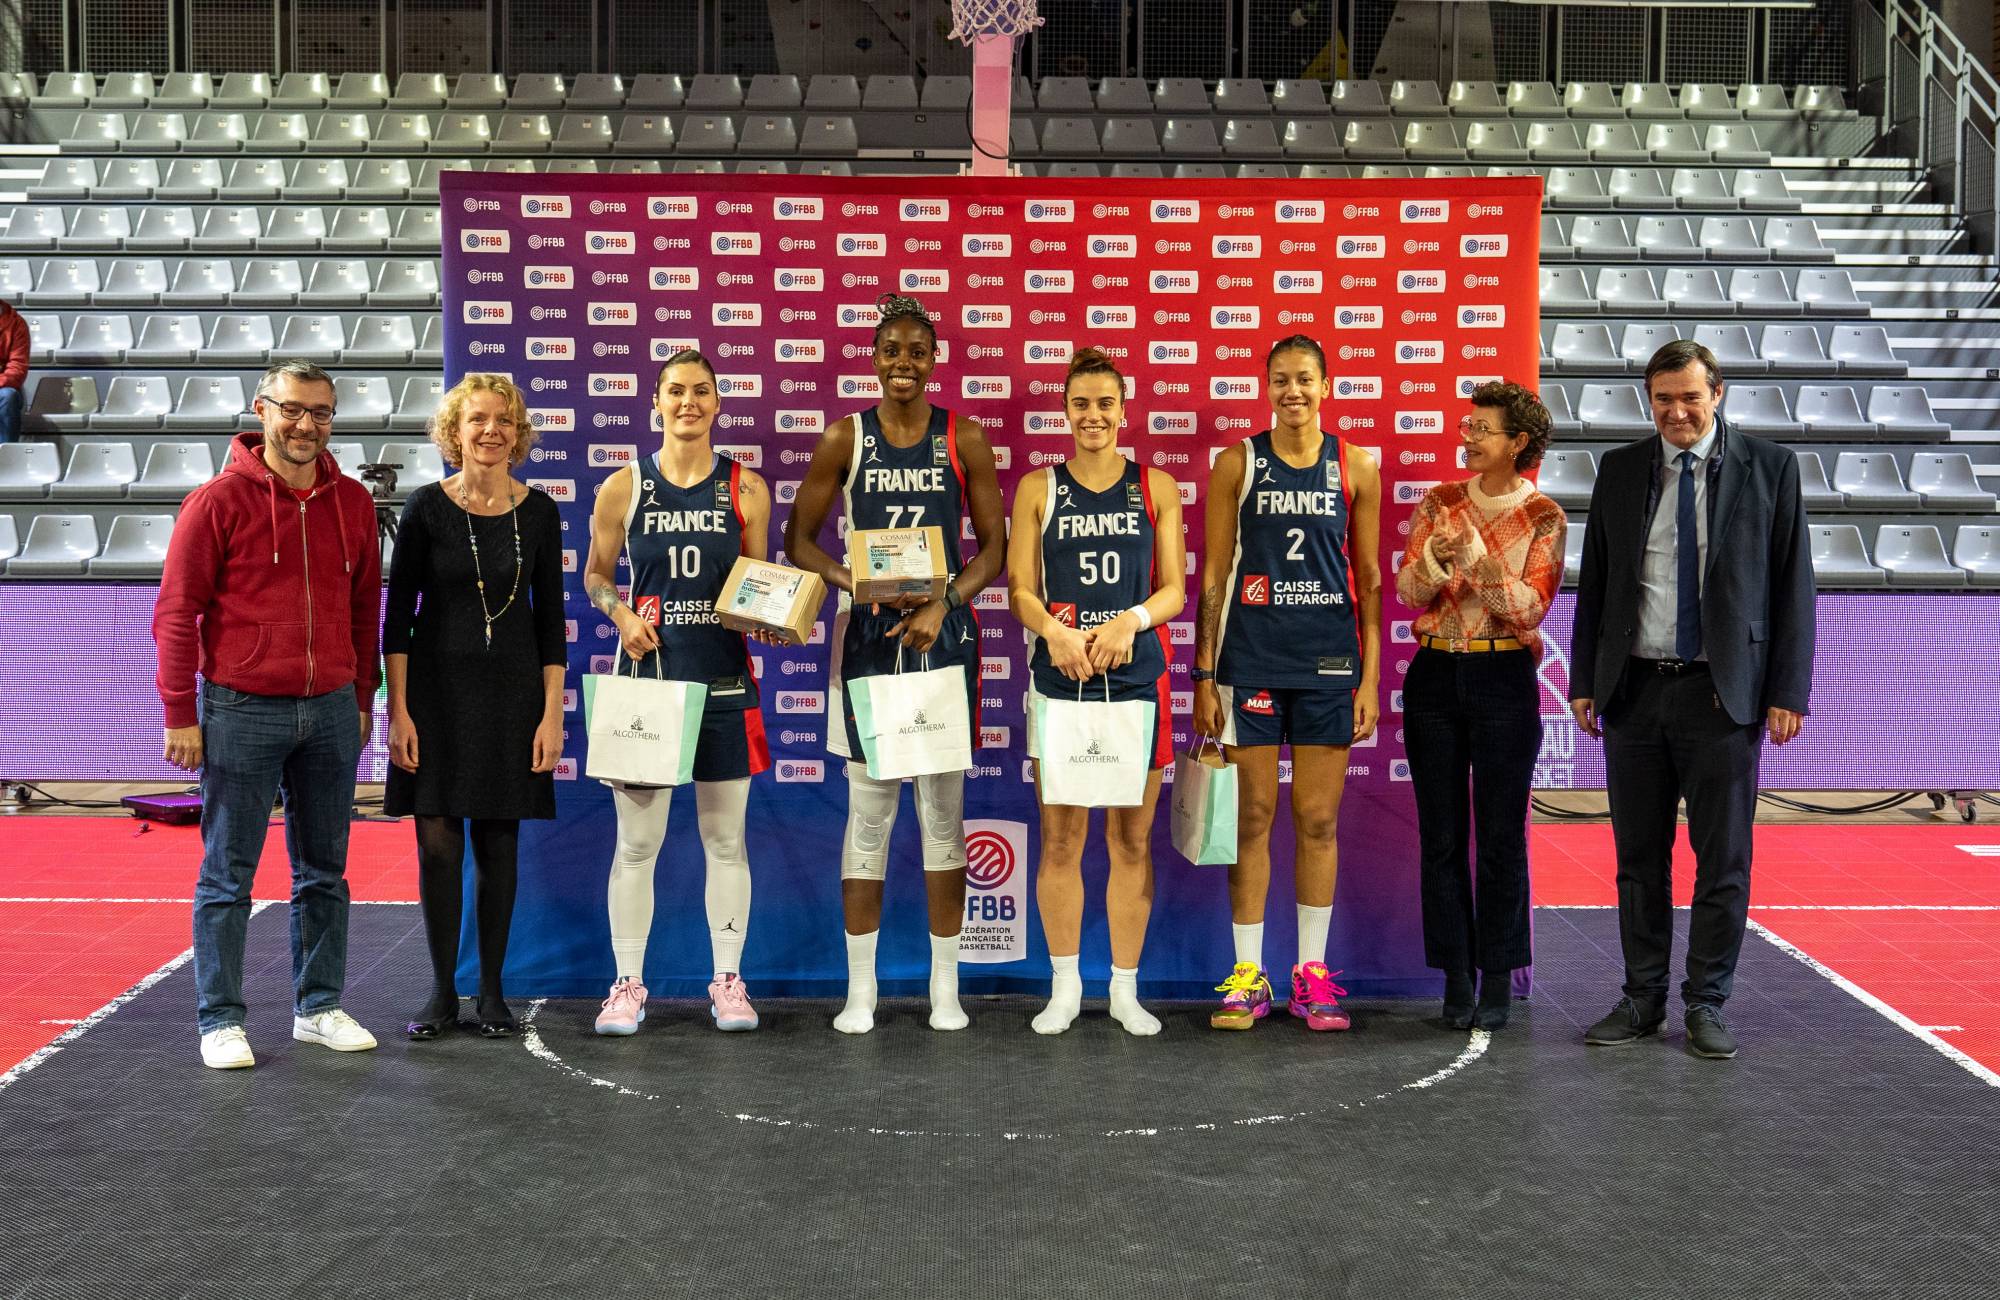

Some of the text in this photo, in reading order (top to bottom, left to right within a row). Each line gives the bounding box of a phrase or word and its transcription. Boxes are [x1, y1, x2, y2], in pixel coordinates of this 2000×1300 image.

[478, 201, 500, 210] FFBB
[542, 202, 563, 211] FFBB
[604, 203, 626, 212] FFBB
[668, 204, 690, 212] FFBB
[731, 204, 753, 213] FFBB
[794, 204, 816, 214] FFBB
[857, 205, 878, 214] FFBB
[920, 206, 941, 215] FFBB
[982, 206, 1004, 215] FFBB
[1045, 206, 1066, 216] FFBB
[1108, 206, 1130, 216] FFBB
[1170, 207, 1192, 216] FFBB
[1233, 207, 1254, 216] FFBB
[1296, 207, 1317, 216] FFBB
[1358, 207, 1380, 216] FFBB
[1420, 207, 1441, 216] FFBB
[1482, 206, 1503, 215] FFBB
[481, 237, 502, 246] FFBB
[543, 237, 565, 247] FFBB
[606, 238, 628, 247] FFBB
[668, 239, 690, 248] FFBB
[732, 239, 753, 248] FFBB
[794, 240, 816, 249] FFBB
[857, 241, 878, 250] FFBB
[920, 241, 942, 250] FFBB
[982, 241, 1004, 250] FFBB
[1045, 241, 1066, 251] FFBB
[1480, 241, 1500, 251] FFBB
[1108, 242, 1129, 251] FFBB
[1170, 242, 1192, 251] FFBB
[1232, 242, 1254, 251] FFBB
[1294, 242, 1316, 252] FFBB
[1356, 243, 1378, 252] FFBB
[1418, 242, 1440, 251] FFBB
[482, 272, 504, 282] FFBB
[544, 273, 566, 282] FFBB
[607, 274, 629, 283] FFBB
[670, 274, 691, 283] FFBB
[732, 274, 754, 284] FFBB
[794, 275, 816, 285] FFBB
[857, 276, 879, 285] FFBB
[920, 276, 941, 285] FFBB
[982, 276, 1004, 286] FFBB
[1045, 277, 1066, 286] FFBB
[1107, 277, 1129, 286] FFBB
[1417, 277, 1438, 286] FFBB
[1478, 276, 1499, 286] FFBB
[1170, 277, 1190, 287] FFBB
[1232, 277, 1253, 287] FFBB
[1294, 278, 1314, 287] FFBB
[1356, 277, 1377, 287] FFBB
[483, 308, 504, 317] FFBB
[545, 309, 567, 318] FFBB
[608, 309, 629, 319] FFBB
[670, 310, 692, 319] FFBB
[732, 310, 754, 320] FFBB
[795, 311, 816, 320] FFBB
[857, 311, 879, 321] FFBB
[982, 312, 1003, 321] FFBB
[1044, 312, 1066, 322] FFBB
[1416, 312, 1437, 322] FFBB
[1477, 312, 1497, 321] FFBB
[1107, 313, 1128, 322] FFBB
[1169, 313, 1190, 322] FFBB
[1231, 313, 1252, 322] FFBB
[1293, 313, 1314, 322] FFBB
[1354, 313, 1375, 322] FFBB
[484, 344, 505, 353] FFBB
[546, 344, 567, 354] FFBB
[608, 345, 630, 354] FFBB
[733, 346, 754, 355] FFBB
[795, 346, 816, 356] FFBB
[982, 347, 1004, 357] FFBB
[1044, 348, 1066, 357] FFBB
[1106, 348, 1128, 357] FFBB
[1168, 348, 1190, 357] FFBB
[1230, 348, 1252, 357] FFBB
[1354, 348, 1375, 357] FFBB
[1415, 348, 1436, 357] FFBB
[1476, 347, 1497, 356] FFBB
[546, 380, 567, 389] FFBB
[608, 380, 630, 390] FFBB
[733, 381, 754, 391] FFBB
[795, 382, 816, 391] FFBB
[858, 382, 879, 391] FFBB
[982, 383, 1003, 392] FFBB
[1044, 383, 1065, 392] FFBB
[1168, 383, 1190, 393] FFBB
[1230, 384, 1251, 393] FFBB
[1353, 383, 1374, 393] FFBB
[1414, 383, 1436, 392] FFBB
[546, 415, 567, 424] FFBB
[608, 416, 630, 425] FFBB
[733, 416, 754, 426] FFBB
[796, 417, 816, 426] FFBB
[982, 418, 1004, 427] FFBB
[1044, 418, 1066, 427] FFBB
[1168, 419, 1189, 428] FFBB
[1230, 418, 1251, 428] FFBB
[1353, 418, 1374, 428] FFBB
[1415, 418, 1436, 427] FFBB
[545, 451, 567, 460] FFBB
[608, 451, 630, 460] FFBB
[733, 452, 754, 461] FFBB
[1044, 454, 1066, 463] FFBB
[1168, 454, 1189, 463] FFBB
[1414, 453, 1436, 462] FFBB
[865, 468, 945, 492] FRANCE
[547, 486, 568, 495] FFBB
[1257, 491, 1337, 516] FRANCE
[643, 510, 727, 534] FRANCE
[886, 506, 925, 529] 77
[1058, 512, 1140, 539] FRANCE
[1287, 528, 1304, 560] 2
[669, 546, 700, 578] 10
[1080, 551, 1120, 584] 50
[1274, 581, 1320, 592] CAISSE
[982, 594, 1003, 603] FFBB
[1275, 593, 1343, 605] D'EPARGNE
[664, 600, 711, 612] CAISSE
[665, 613, 720, 625] D'EPARG
[982, 628, 1003, 638] FFBB
[796, 663, 817, 672] FFBB
[796, 698, 817, 707] FFBB
[982, 698, 1003, 708] FFBB
[1248, 699, 1272, 708] MAIF
[898, 723, 946, 734] ALGOTHERM
[613, 730, 660, 741] ALGOTHERM
[796, 733, 817, 742] FFBB
[796, 767, 816, 776] FFBB
[980, 767, 1002, 776] FFBB
[1348, 766, 1370, 775] FFBB
[968, 896, 1016, 921] FBB
